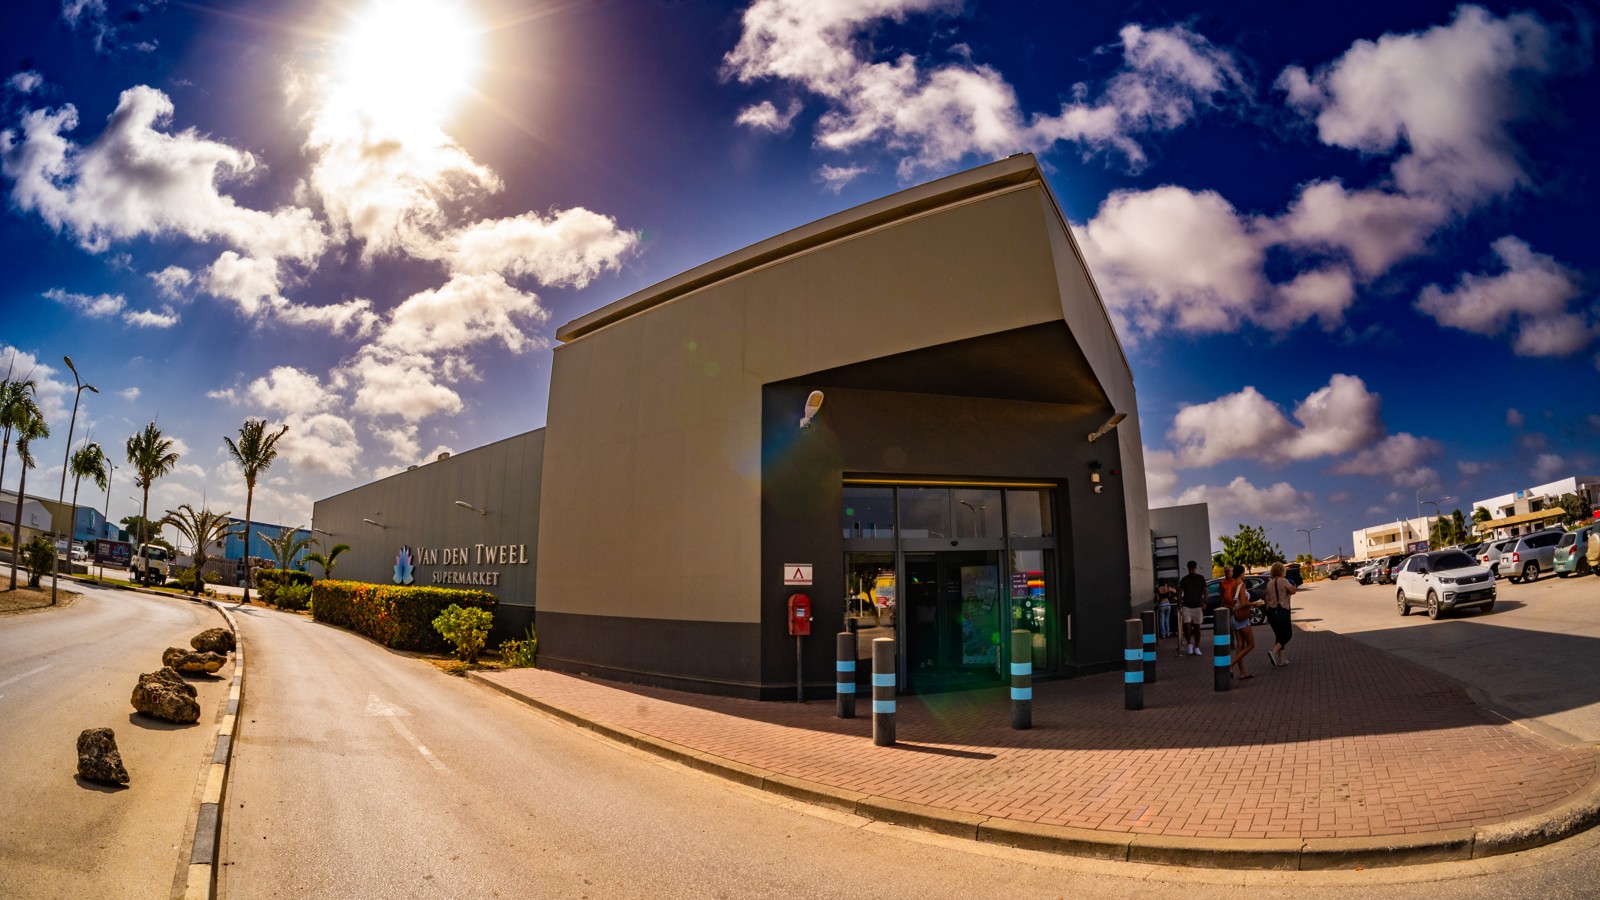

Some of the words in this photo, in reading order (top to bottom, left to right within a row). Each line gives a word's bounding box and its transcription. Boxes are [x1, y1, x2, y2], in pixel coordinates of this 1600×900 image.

[417, 547, 438, 565] VAN
[443, 547, 469, 565] DEN
[475, 543, 529, 564] TWEEL
[432, 571, 500, 586] SUPERMARKET
